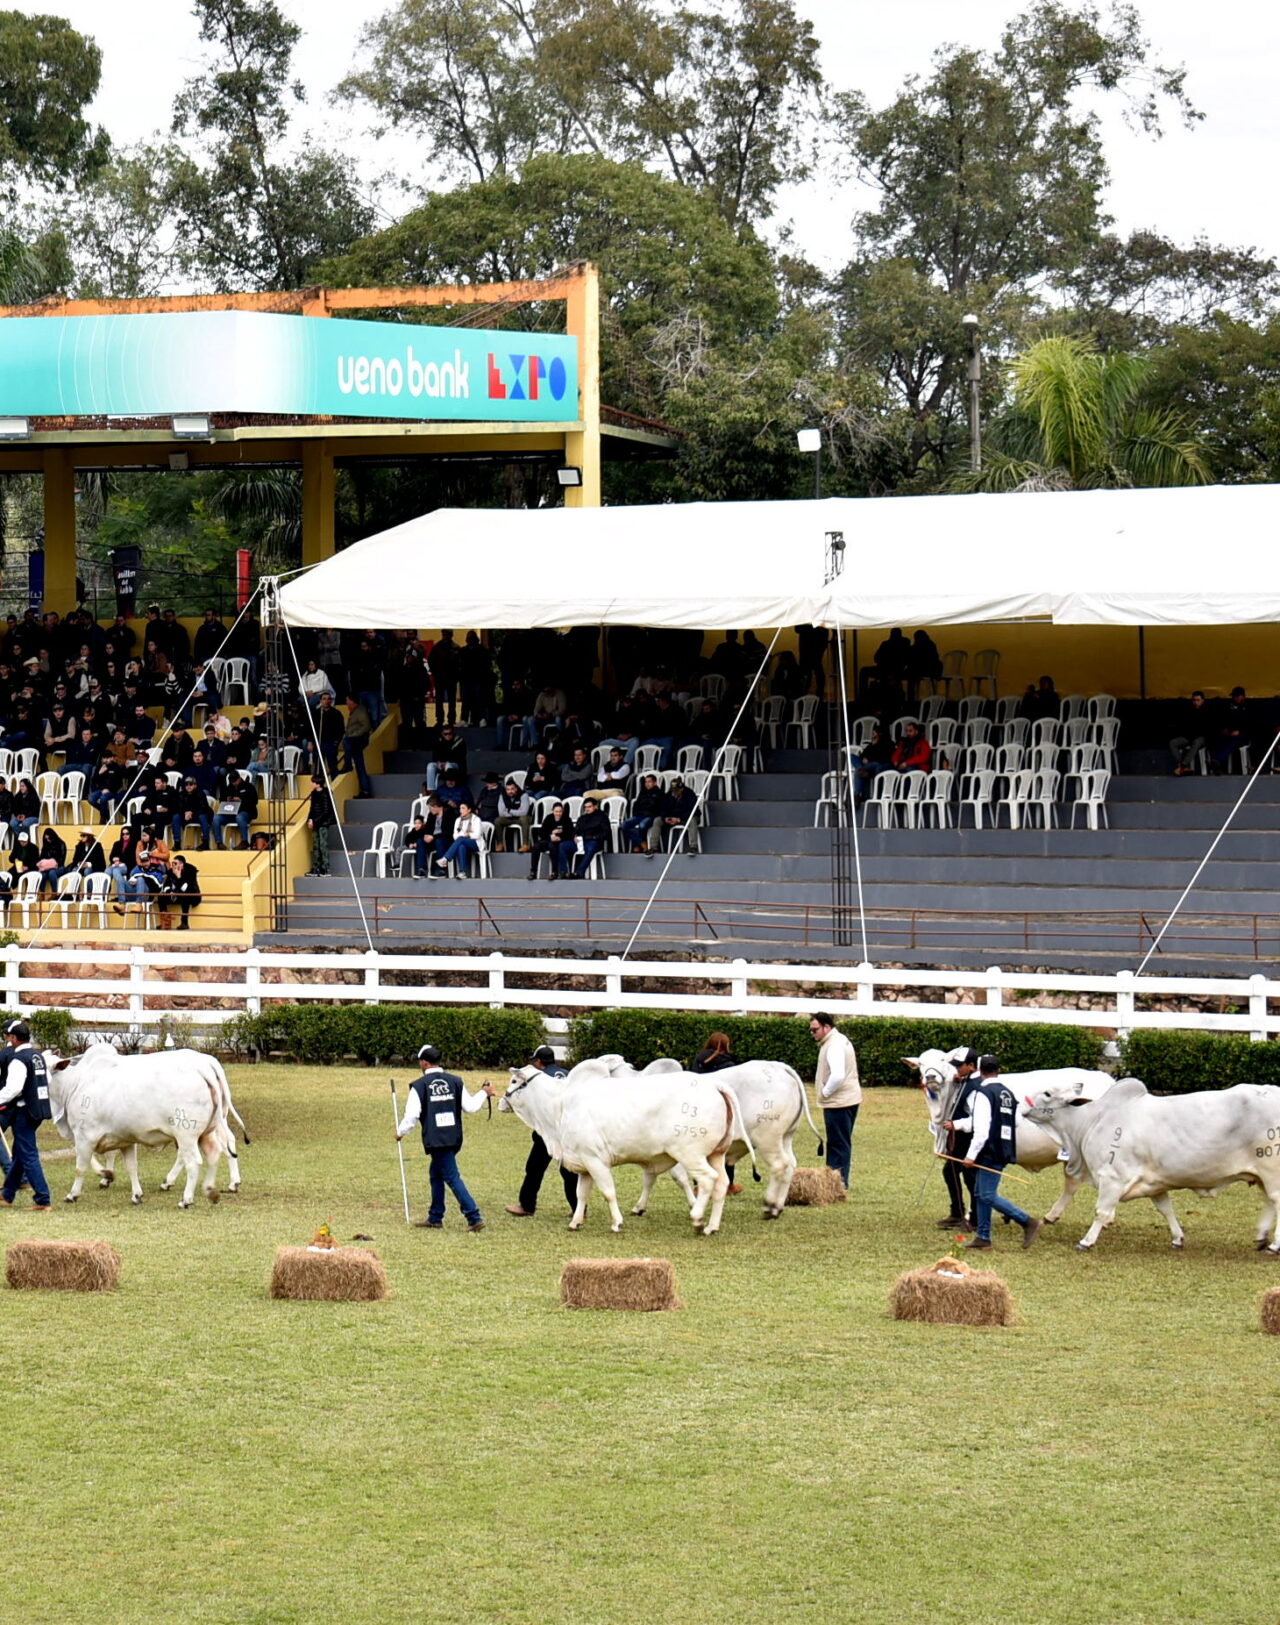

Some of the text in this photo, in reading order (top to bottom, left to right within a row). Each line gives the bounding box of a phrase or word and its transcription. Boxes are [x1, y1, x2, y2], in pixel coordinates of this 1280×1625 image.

[337, 345, 469, 398] ueno bank
[487, 353, 566, 401] EXPO
